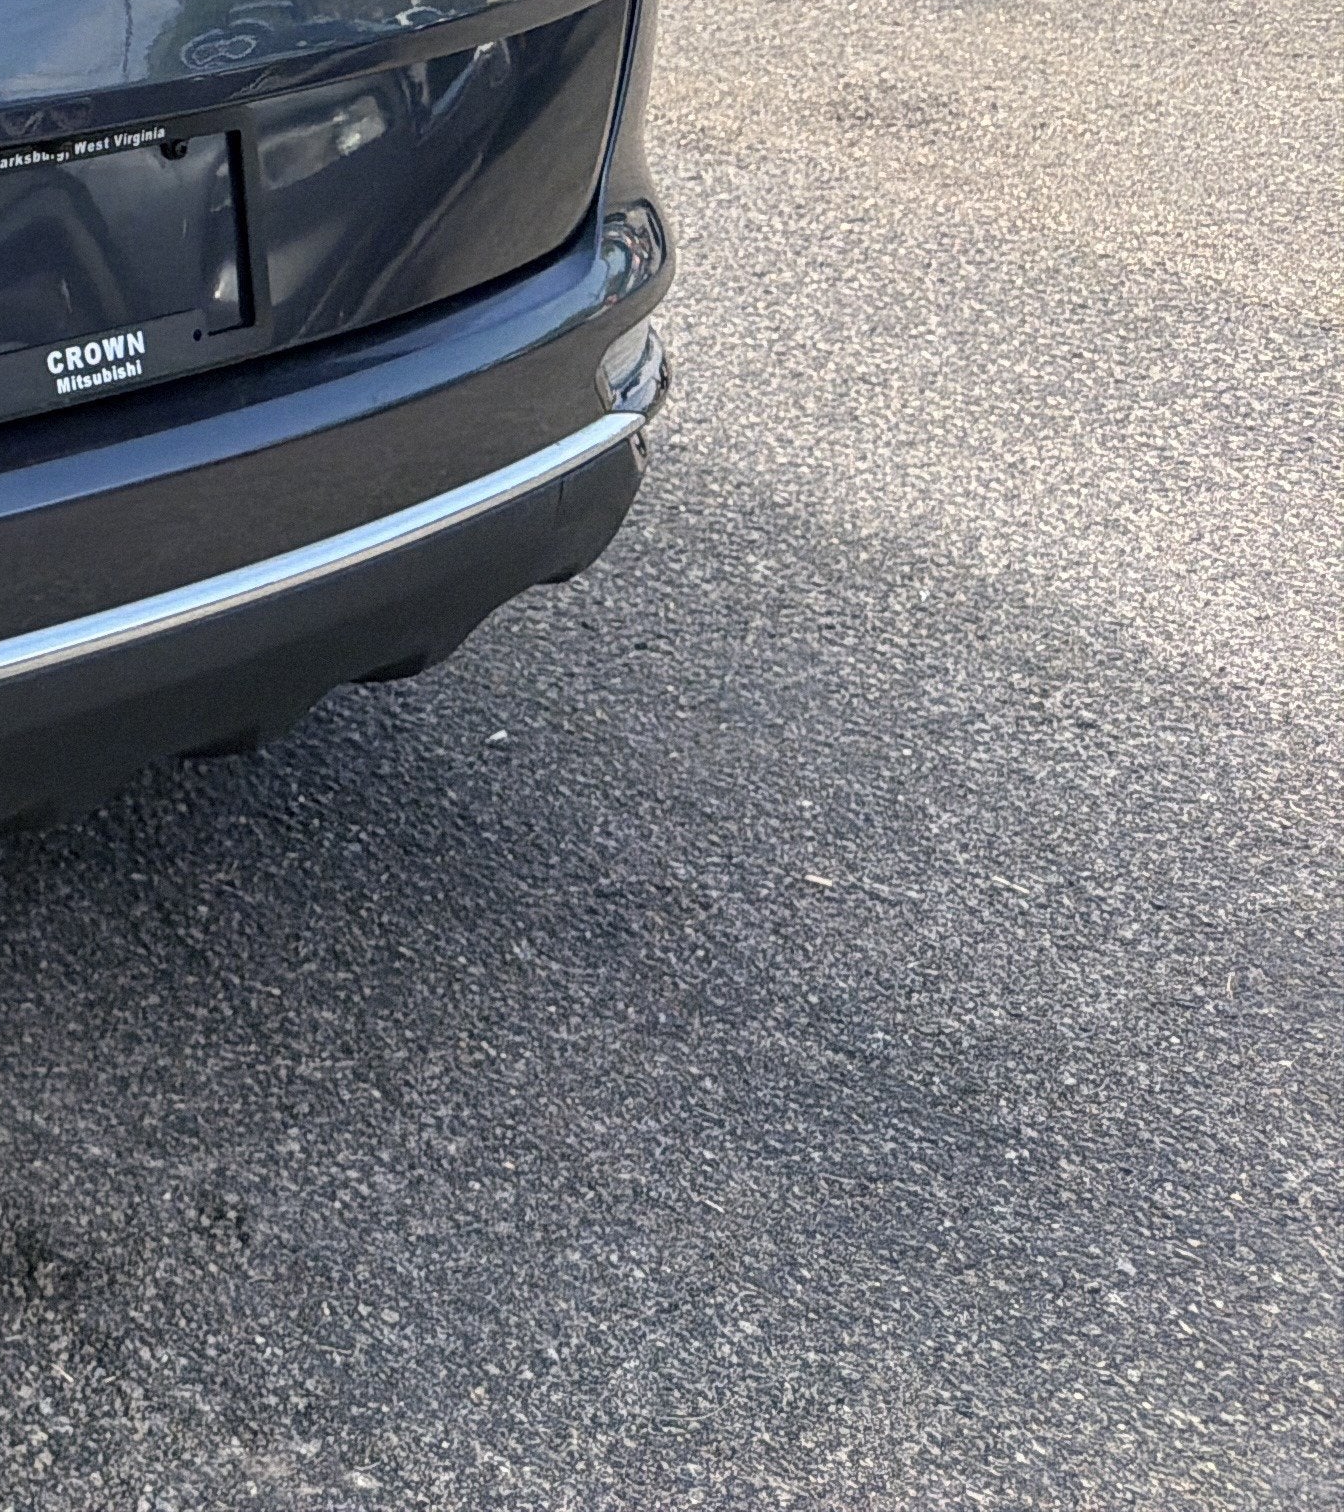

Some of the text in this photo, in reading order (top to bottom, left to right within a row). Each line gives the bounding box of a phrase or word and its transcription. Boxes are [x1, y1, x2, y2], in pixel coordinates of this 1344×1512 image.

[74, 137, 110, 155] West
[113, 127, 166, 147] Virginia
[46, 330, 146, 374] CROWN
[56, 359, 143, 395] Mitsubishi
